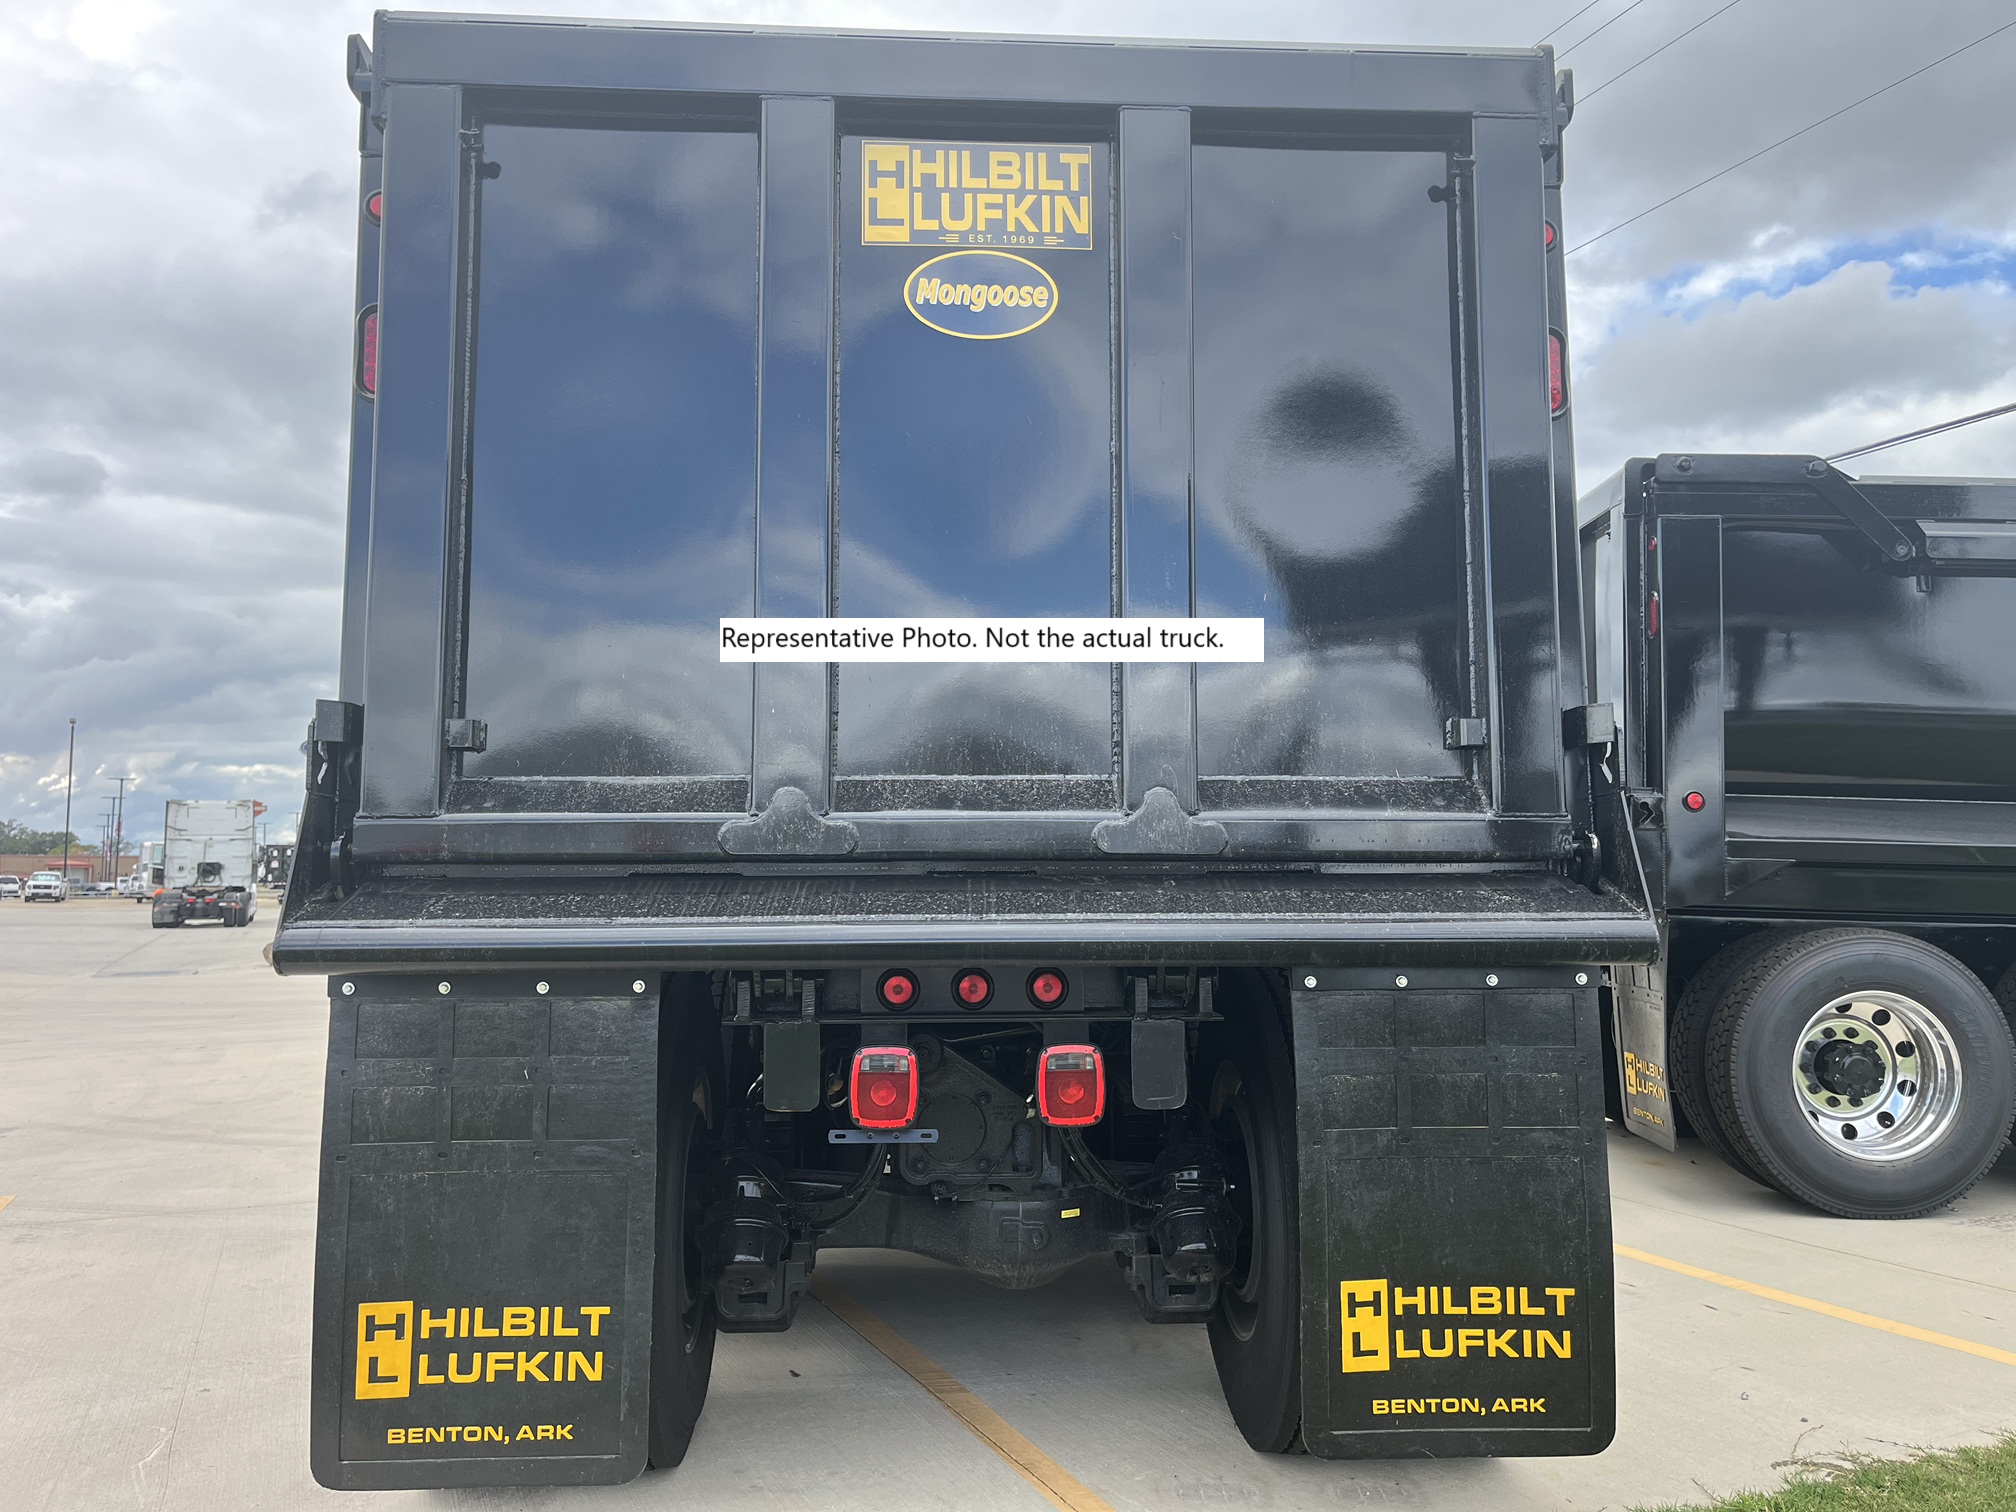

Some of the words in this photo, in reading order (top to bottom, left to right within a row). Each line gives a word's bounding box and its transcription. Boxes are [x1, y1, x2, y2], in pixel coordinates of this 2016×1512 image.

[912, 149, 1089, 191] HILBILT
[913, 192, 1089, 234] LUFKIN
[968, 234, 996, 243] EST.
[1002, 235, 1035, 244] 1969
[915, 277, 1049, 312] Mongoose
[1636, 1058, 1664, 1082] HILBILT
[1637, 1078, 1666, 1102] LUFKIN
[1394, 1286, 1576, 1316] HILBILT
[420, 1306, 611, 1339] HILBILT
[1395, 1329, 1572, 1358] LUFKIN
[418, 1351, 603, 1384] LUFKIN
[1372, 1398, 1486, 1416] BENTON,
[1491, 1398, 1546, 1413] ARK
[387, 1426, 510, 1445] BENTON,
[515, 1424, 573, 1440] ARK
